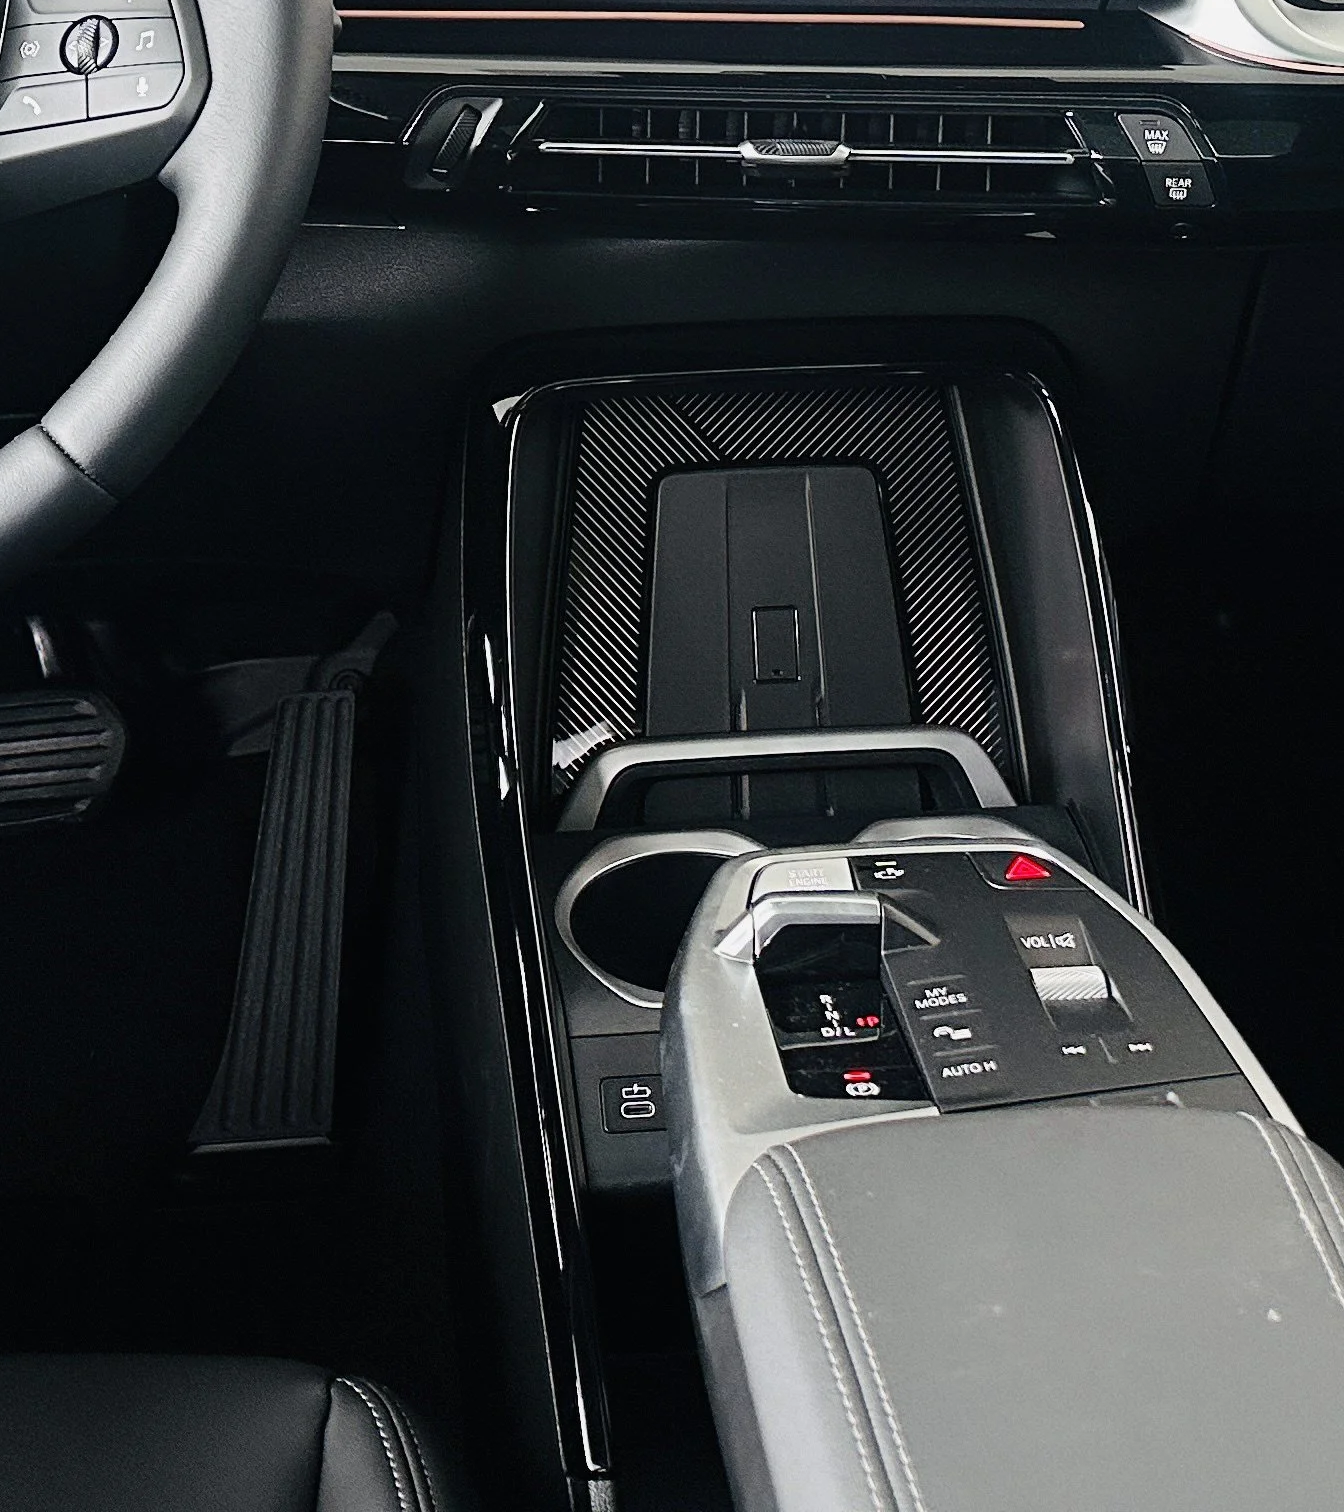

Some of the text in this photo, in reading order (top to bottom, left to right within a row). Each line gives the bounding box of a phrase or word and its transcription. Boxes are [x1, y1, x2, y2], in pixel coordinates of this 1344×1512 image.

[1144, 129, 1170, 141] MAX
[1165, 178, 1192, 188] REAR
[788, 868, 824, 879] START
[924, 987, 947, 999] MY
[915, 993, 968, 1009] MODES
[825, 1010, 840, 1020] N
[942, 1060, 997, 1078] AUTO H
